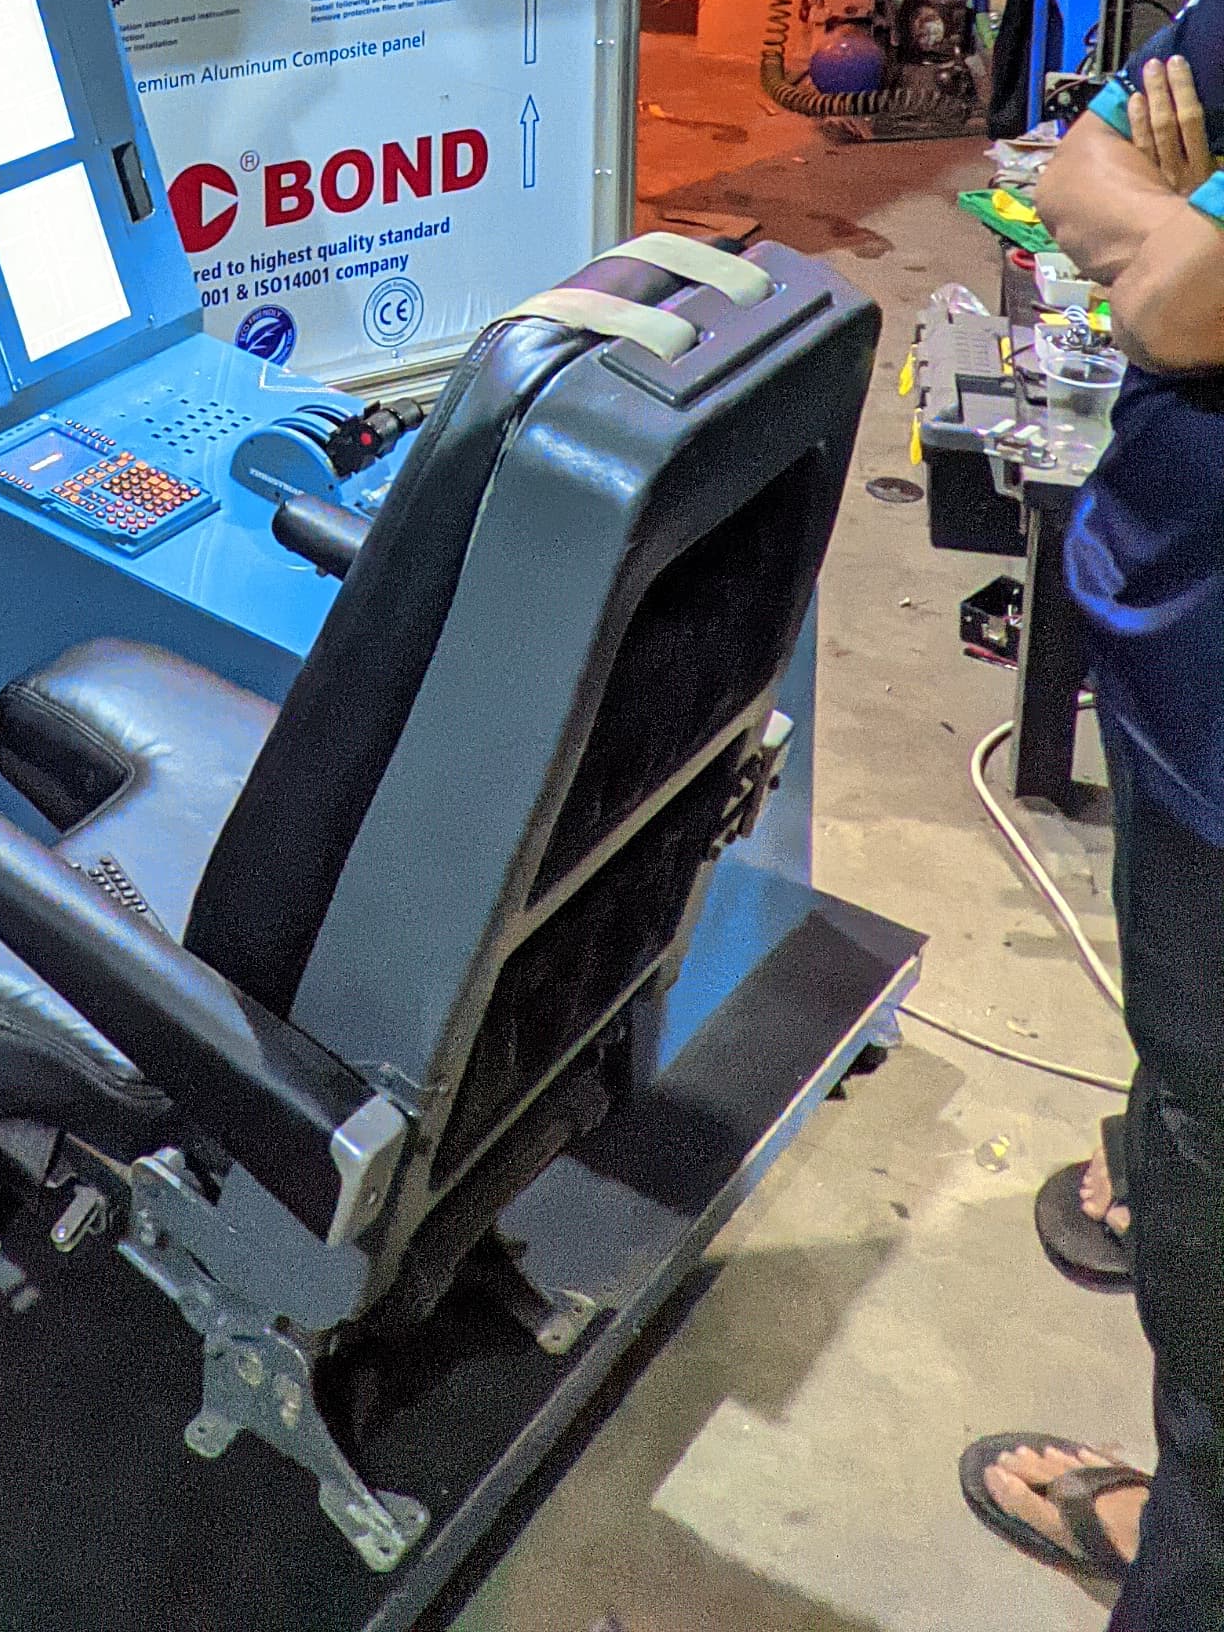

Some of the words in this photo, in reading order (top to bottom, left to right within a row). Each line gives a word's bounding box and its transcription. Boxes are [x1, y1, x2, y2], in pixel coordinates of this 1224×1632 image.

[145, 15, 179, 28] standard
[181, 13, 196, 22] and
[197, 8, 240, 20] instruction
[311, 2, 334, 13] Install
[311, 12, 341, 23] Remove
[343, 5, 380, 19] protective
[382, 2, 396, 12] film
[398, 0, 415, 10] after
[133, 39, 178, 52] installation
[137, 72, 195, 94] emium
[201, 59, 287, 84] Aluminum
[292, 44, 377, 69] Composite
[382, 30, 425, 58] panel
[265, 128, 488, 227] BOND
[193, 262, 221, 283] red
[227, 259, 245, 275] to
[250, 245, 313, 272] highest
[317, 234, 374, 262] quality
[379, 216, 450, 246] standard
[201, 287, 229, 308] 001
[236, 284, 249, 300] &
[254, 267, 329, 296] ISO14001
[336, 253, 409, 280] company
